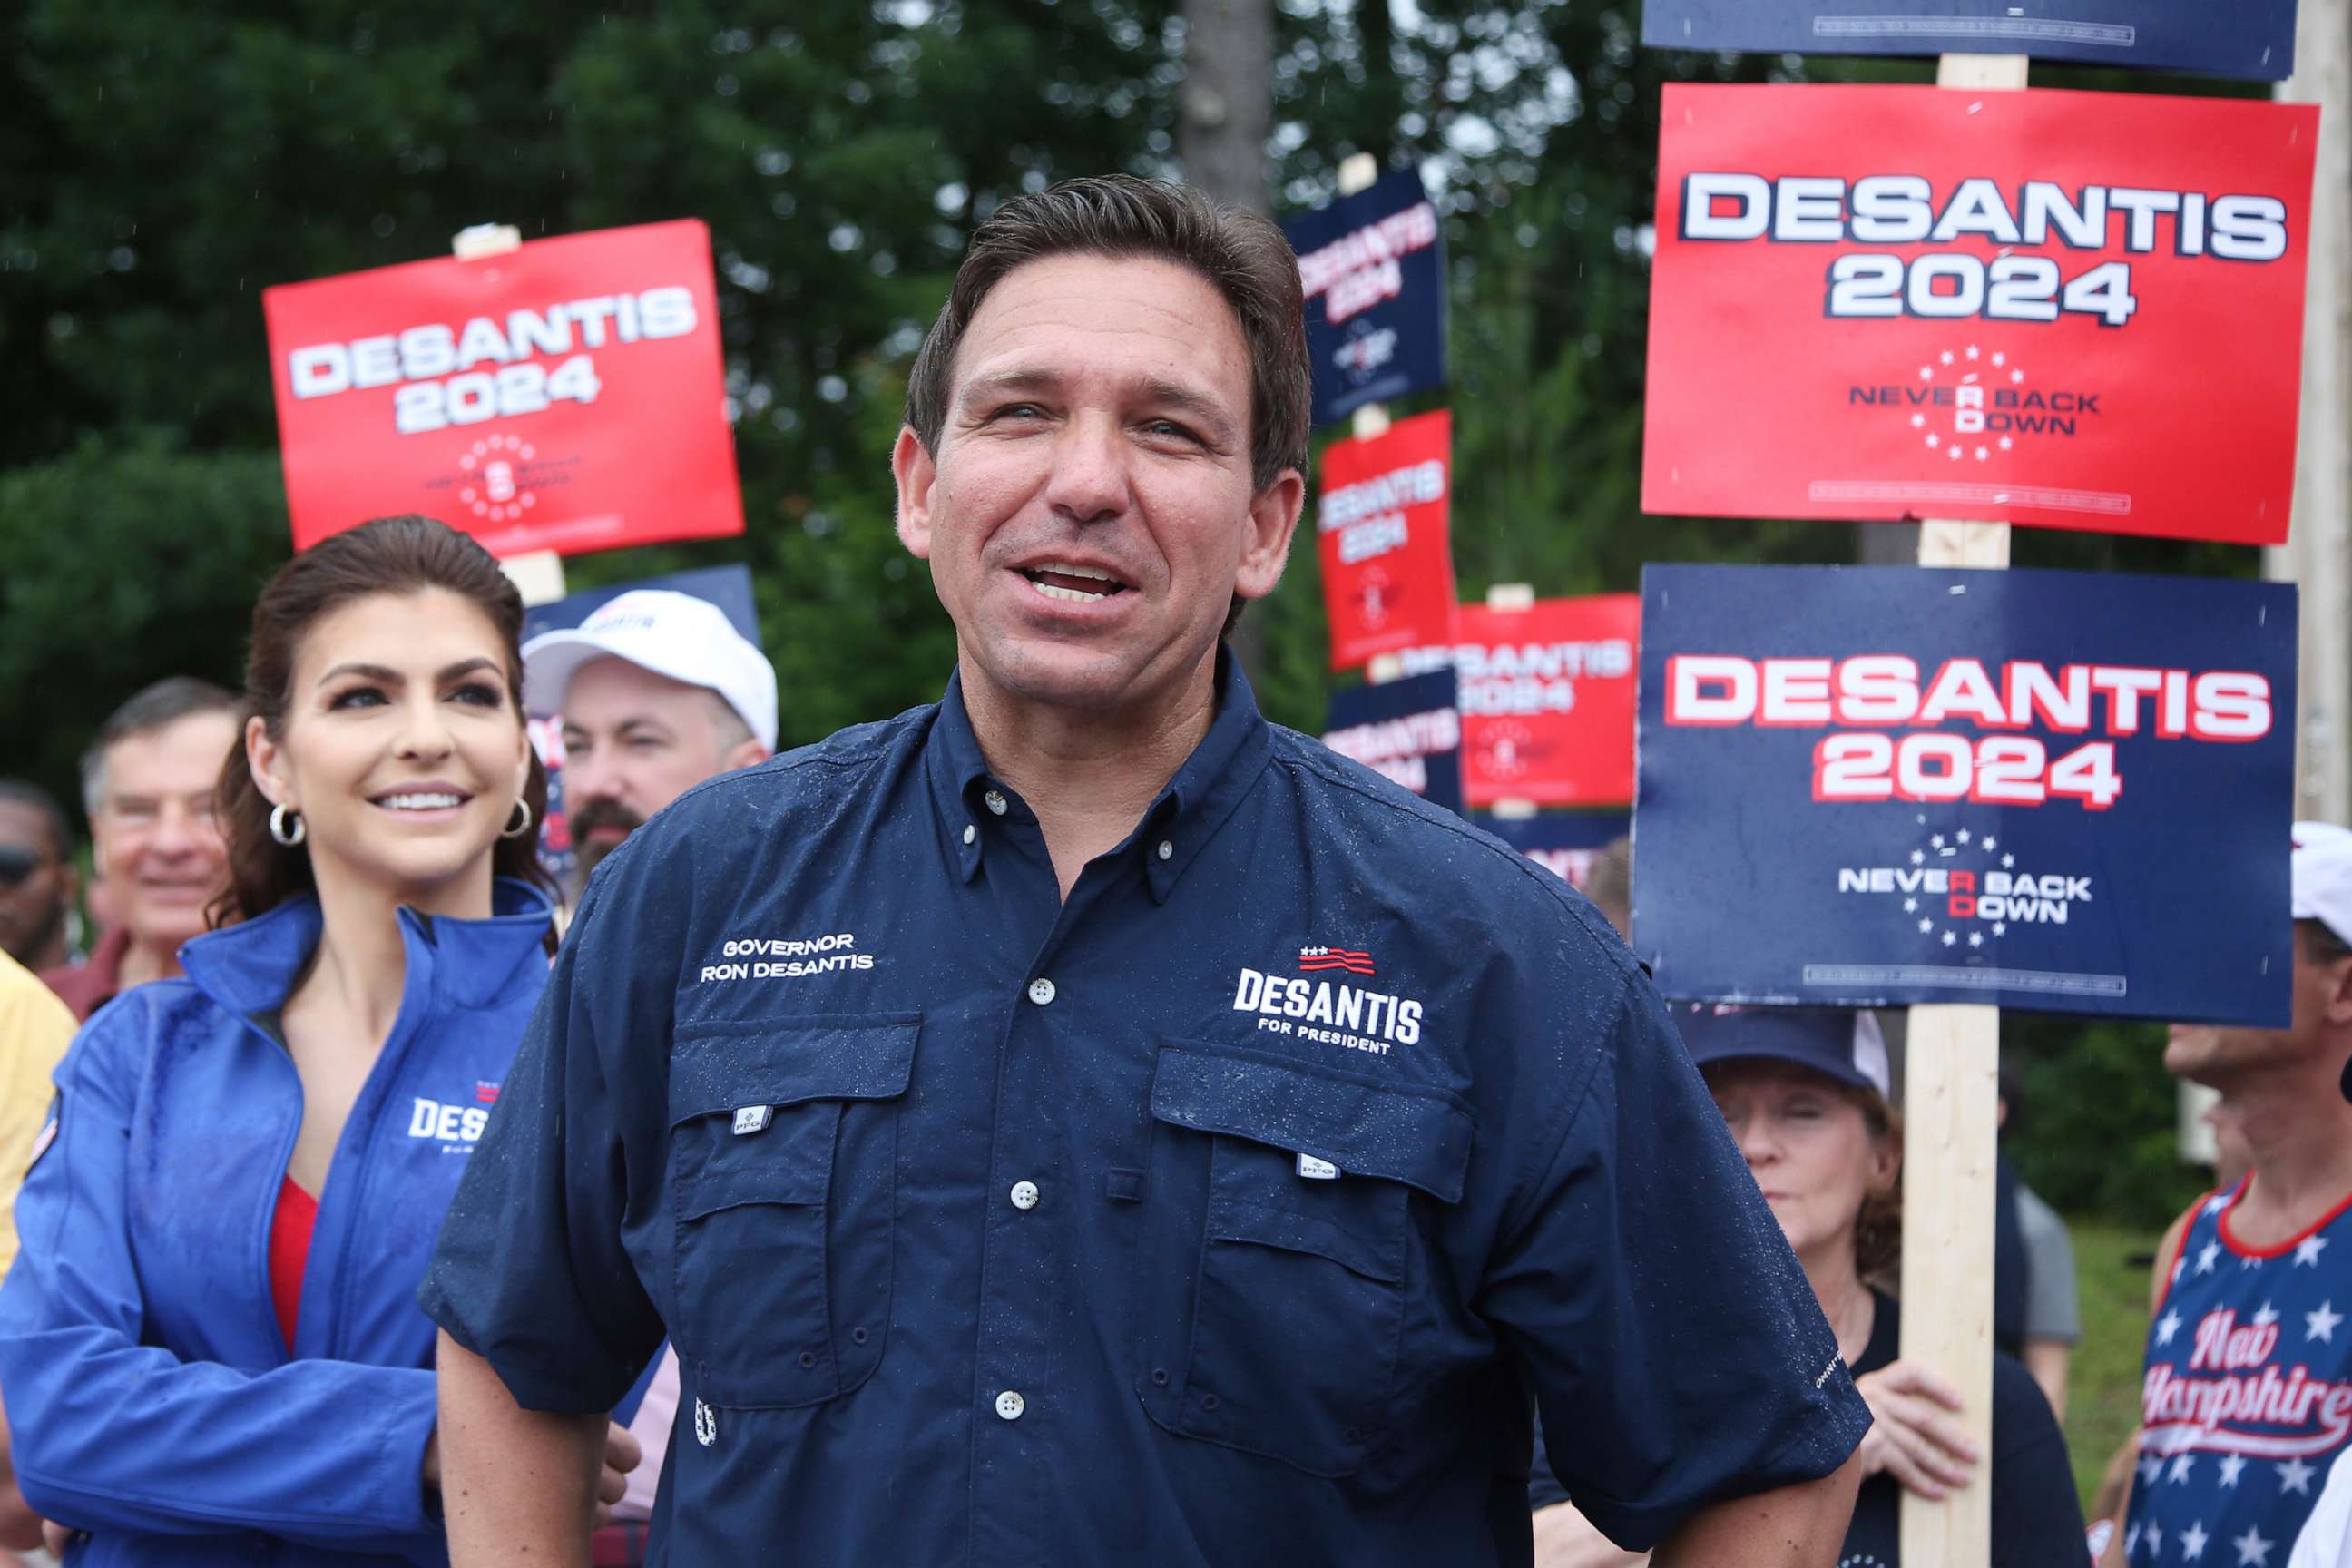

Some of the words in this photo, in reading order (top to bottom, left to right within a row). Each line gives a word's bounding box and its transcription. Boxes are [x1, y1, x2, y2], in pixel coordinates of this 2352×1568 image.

[1679, 172, 2288, 260] DESANTIS
[1823, 252, 2137, 327] 2024
[289, 286, 698, 400] DESANTIS
[394, 354, 602, 435] 2024
[1849, 385, 1984, 409] NEVER
[1994, 388, 2102, 415] BACK
[1955, 408, 2077, 436] DOWN
[1664, 653, 2272, 742] DESANTIS
[1813, 732, 2124, 810] 2024
[1838, 868, 1975, 894] NEVER
[1984, 871, 2093, 902] BACK
[1948, 895, 2069, 924] DOWN
[701, 963, 749, 983] RON
[753, 954, 875, 979] DESANTIS
[722, 934, 855, 957] GOVERNOR
[1233, 967, 1424, 1045] DESANTIS
[1258, 1017, 1292, 1035] FOR
[1297, 1025, 1392, 1056] PRESIDENT
